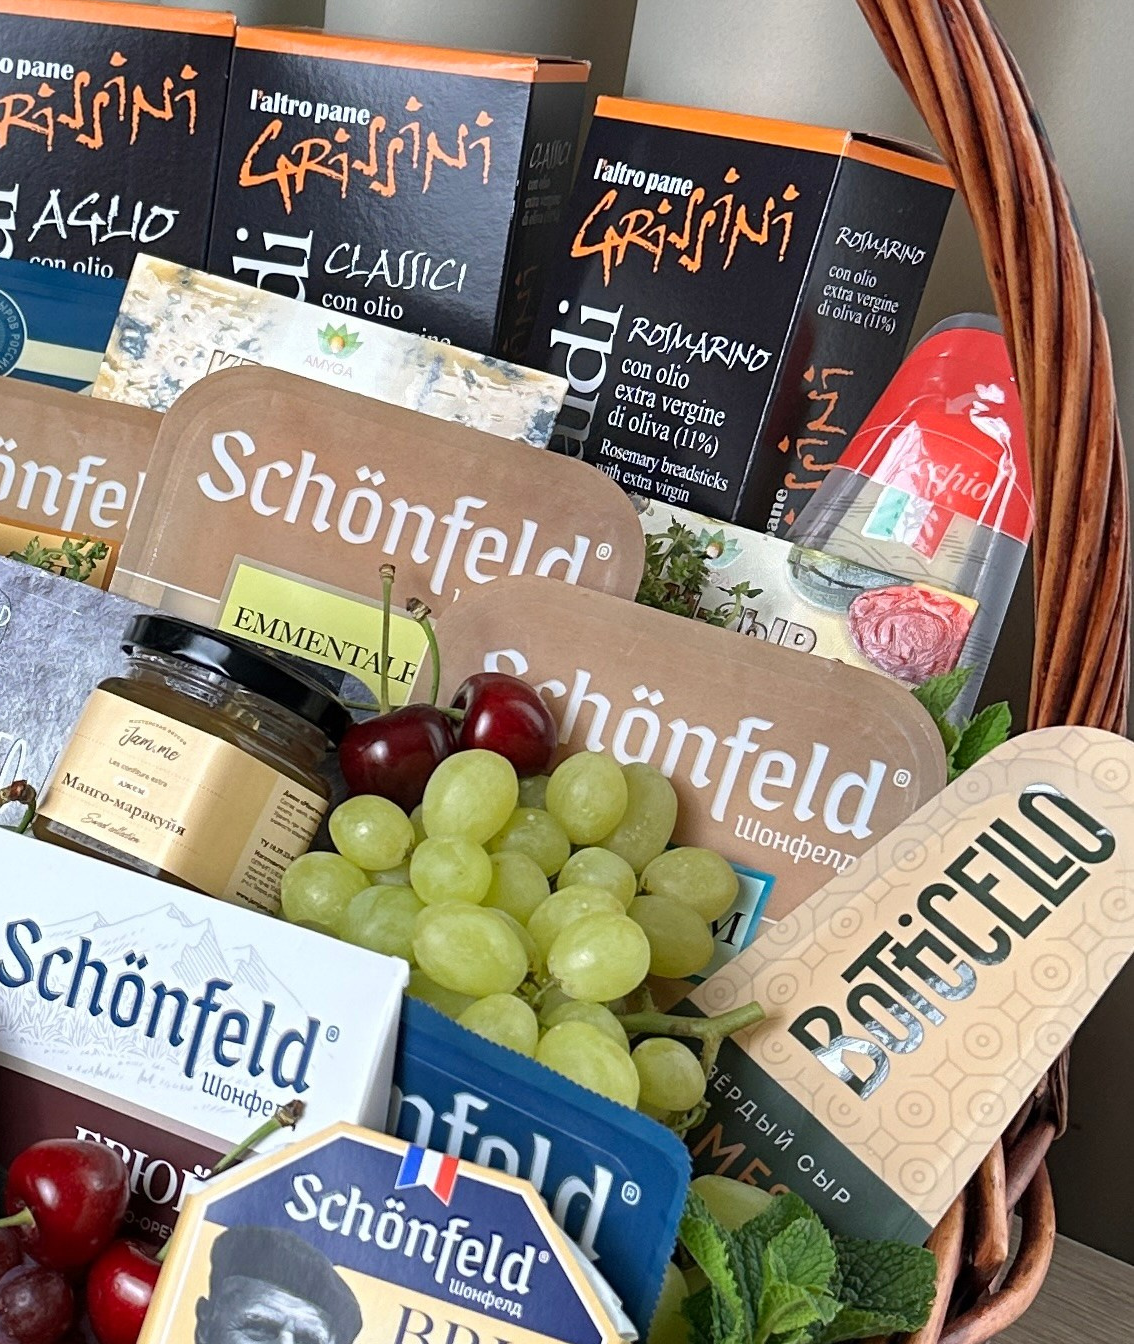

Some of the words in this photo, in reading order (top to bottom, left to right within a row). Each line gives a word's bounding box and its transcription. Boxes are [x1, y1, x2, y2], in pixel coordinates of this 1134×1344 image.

[16, 57, 75, 81] pane
[315, 101, 370, 126] pane
[644, 172, 693, 196] pane
[27, 188, 180, 246] AGLIO
[835, 226, 926, 265] ROSMARINO
[72, 256, 113, 278] olio
[324, 242, 467, 293] CLASSICI
[828, 265, 850, 282] con
[853, 269, 877, 288] olio
[322, 290, 358, 312] con
[364, 292, 403, 320] olio
[817, 300, 832, 316] di
[832, 304, 862, 325] oliva
[864, 313, 896, 336] (11%)
[823, 283, 853, 303] extra
[857, 294, 899, 314] vergine
[627, 317, 772, 372] ROSMARINO
[303, 354, 353, 378] AMYGA
[621, 357, 650, 382] con
[655, 362, 690, 389] olio
[614, 382, 656, 409] extra
[662, 398, 725, 431] vergine
[607, 405, 623, 429] di
[628, 410, 669, 441] oliva
[673, 426, 719, 459] (11%)
[600, 438, 660, 474] Rosemary
[661, 456, 729, 491] breadsticks
[623, 471, 652, 491] extra
[656, 479, 690, 503] virgin
[233, 605, 418, 686] EMMENTALE
[61, 772, 186, 837] Манго-маракуйя
[797, 1154, 851, 1203] СЫР
[285, 1173, 537, 1295] Schönfeld
[449, 1278, 523, 1319] Шонфелд
